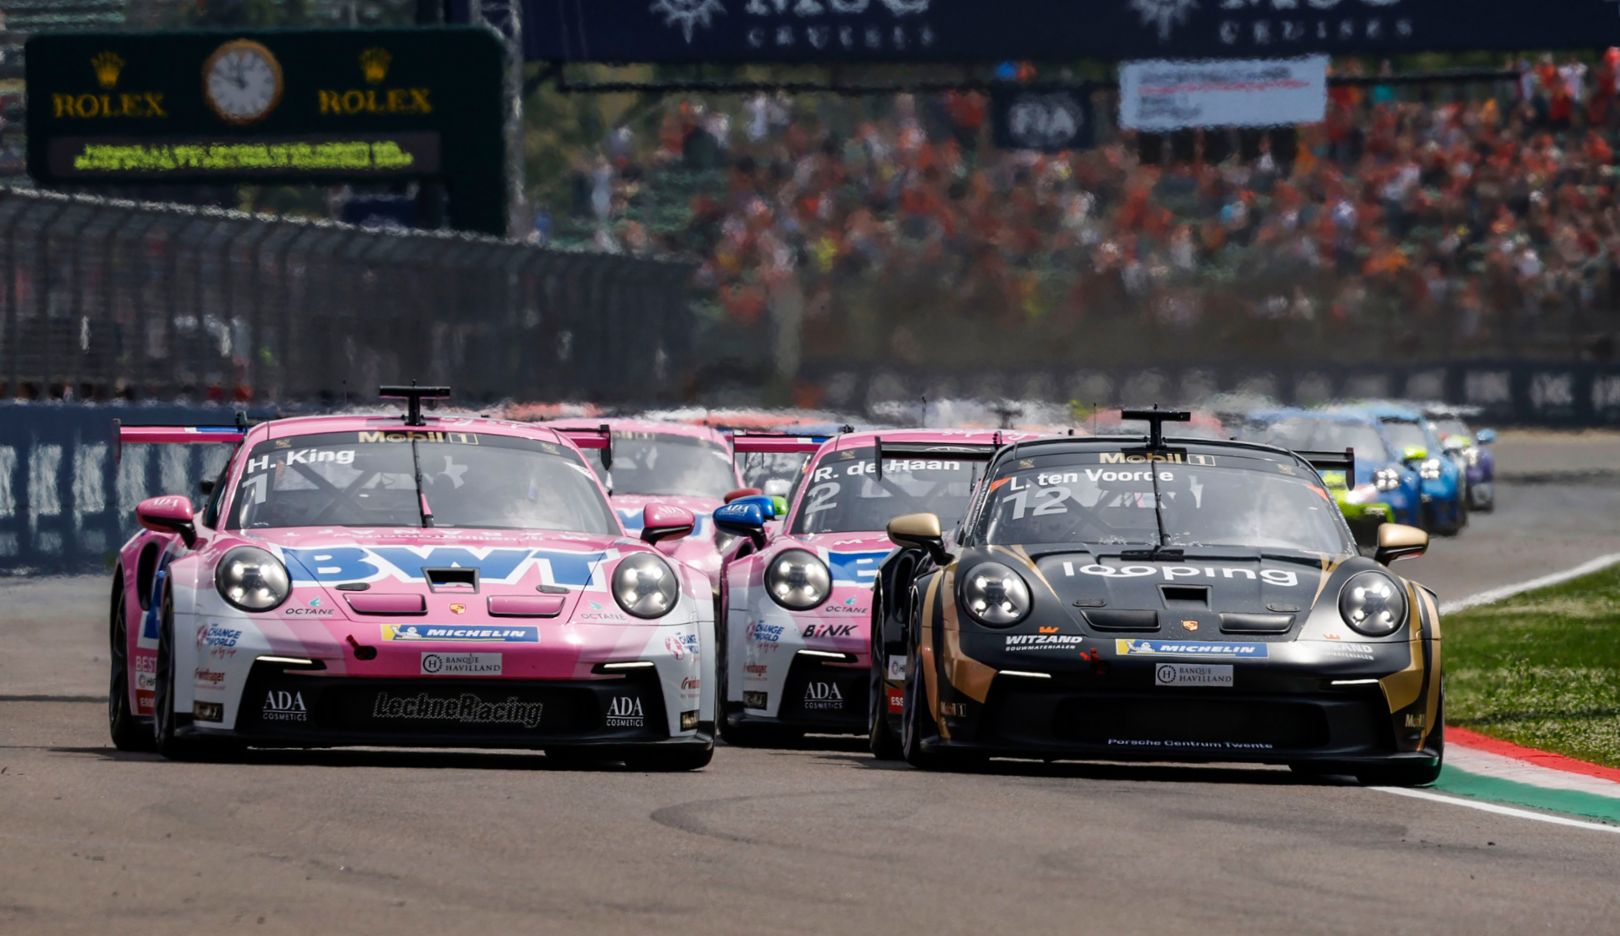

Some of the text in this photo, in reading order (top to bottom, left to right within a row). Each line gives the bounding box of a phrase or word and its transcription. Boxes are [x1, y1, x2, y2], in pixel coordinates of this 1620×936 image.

[53, 93, 167, 119] ROLEX
[317, 88, 434, 115] ROLEX
[358, 431, 445, 444] Mobil
[247, 449, 355, 474] H. King
[1100, 452, 1183, 465] Mobil
[814, 459, 960, 483] R. de Haan
[242, 473, 268, 505] 1
[1010, 477, 1030, 491] L.
[1037, 472, 1078, 486] ten
[805, 481, 841, 514] 2
[1002, 486, 1072, 520] 12
[281, 546, 617, 592] BWT
[1062, 561, 1298, 586] looping
[285, 608, 335, 616] OCTANE
[825, 605, 868, 614] OCTANE
[427, 628, 526, 638] MICHELIN
[802, 624, 859, 638] BiNK
[1005, 635, 1083, 645] WITZAND
[1159, 645, 1256, 653] MICHELIN
[446, 656, 480, 664] BANQUE
[446, 664, 501, 672] HAVILLAND
[804, 682, 843, 700] ADA
[263, 690, 307, 711] ADA
[607, 696, 644, 716] ADA
[263, 713, 307, 721] COSMETICS
[606, 719, 644, 727] COSMETICS
[1107, 738, 1273, 749] Porsche Centrum Twente
